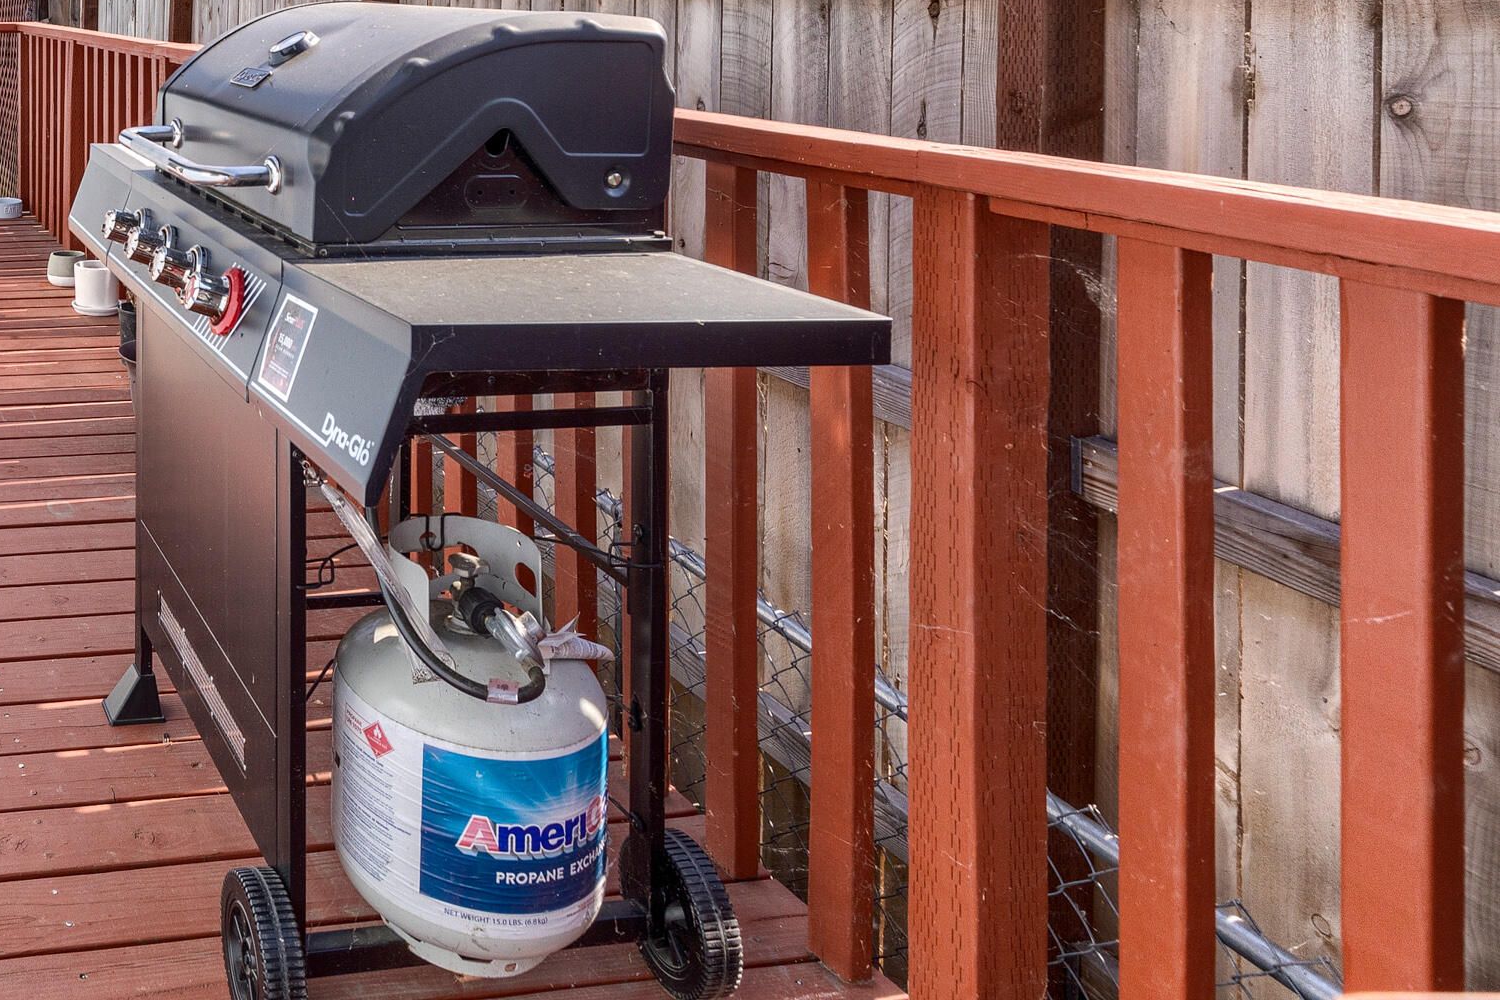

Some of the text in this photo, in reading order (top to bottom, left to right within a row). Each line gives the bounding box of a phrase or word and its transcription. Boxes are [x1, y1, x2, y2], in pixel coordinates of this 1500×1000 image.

[495, 866, 565, 885] PROPANE
[444, 907, 459, 917] NET
[460, 912, 490, 924] WEIGHT
[492, 918, 507, 926] 15.0
